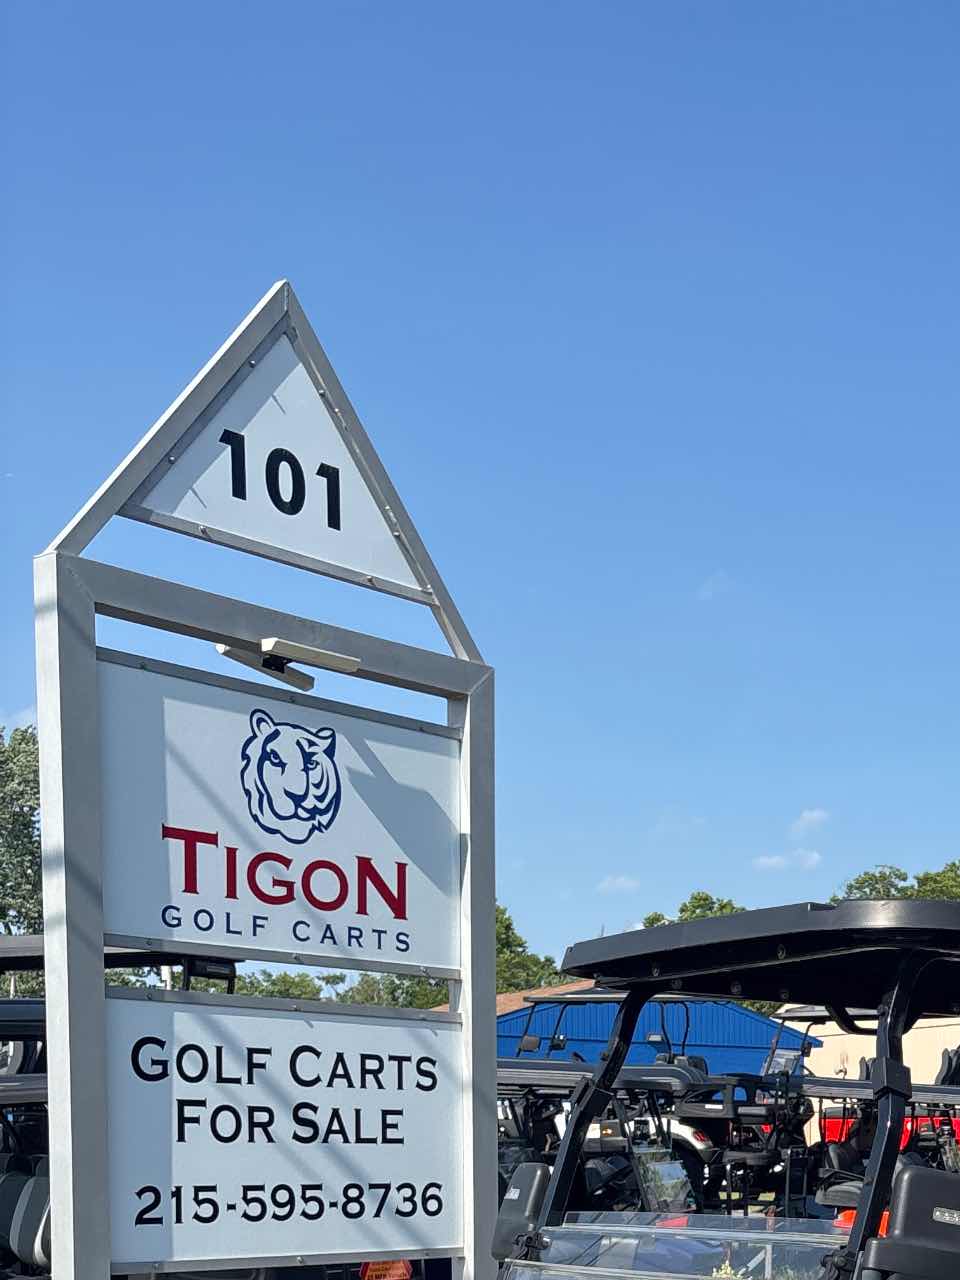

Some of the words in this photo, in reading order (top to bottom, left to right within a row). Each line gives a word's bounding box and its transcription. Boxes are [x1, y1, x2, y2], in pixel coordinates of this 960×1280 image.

[218, 428, 341, 532] 101
[161, 823, 408, 921] TIGON
[161, 904, 269, 938] GOLF
[292, 920, 410, 953] CARTS
[130, 1036, 272, 1085] GOLF
[289, 1044, 438, 1092] CARTS
[175, 1098, 276, 1144] FOR
[291, 1101, 405, 1145] SALE
[134, 1182, 444, 1228] 215-595-8736
